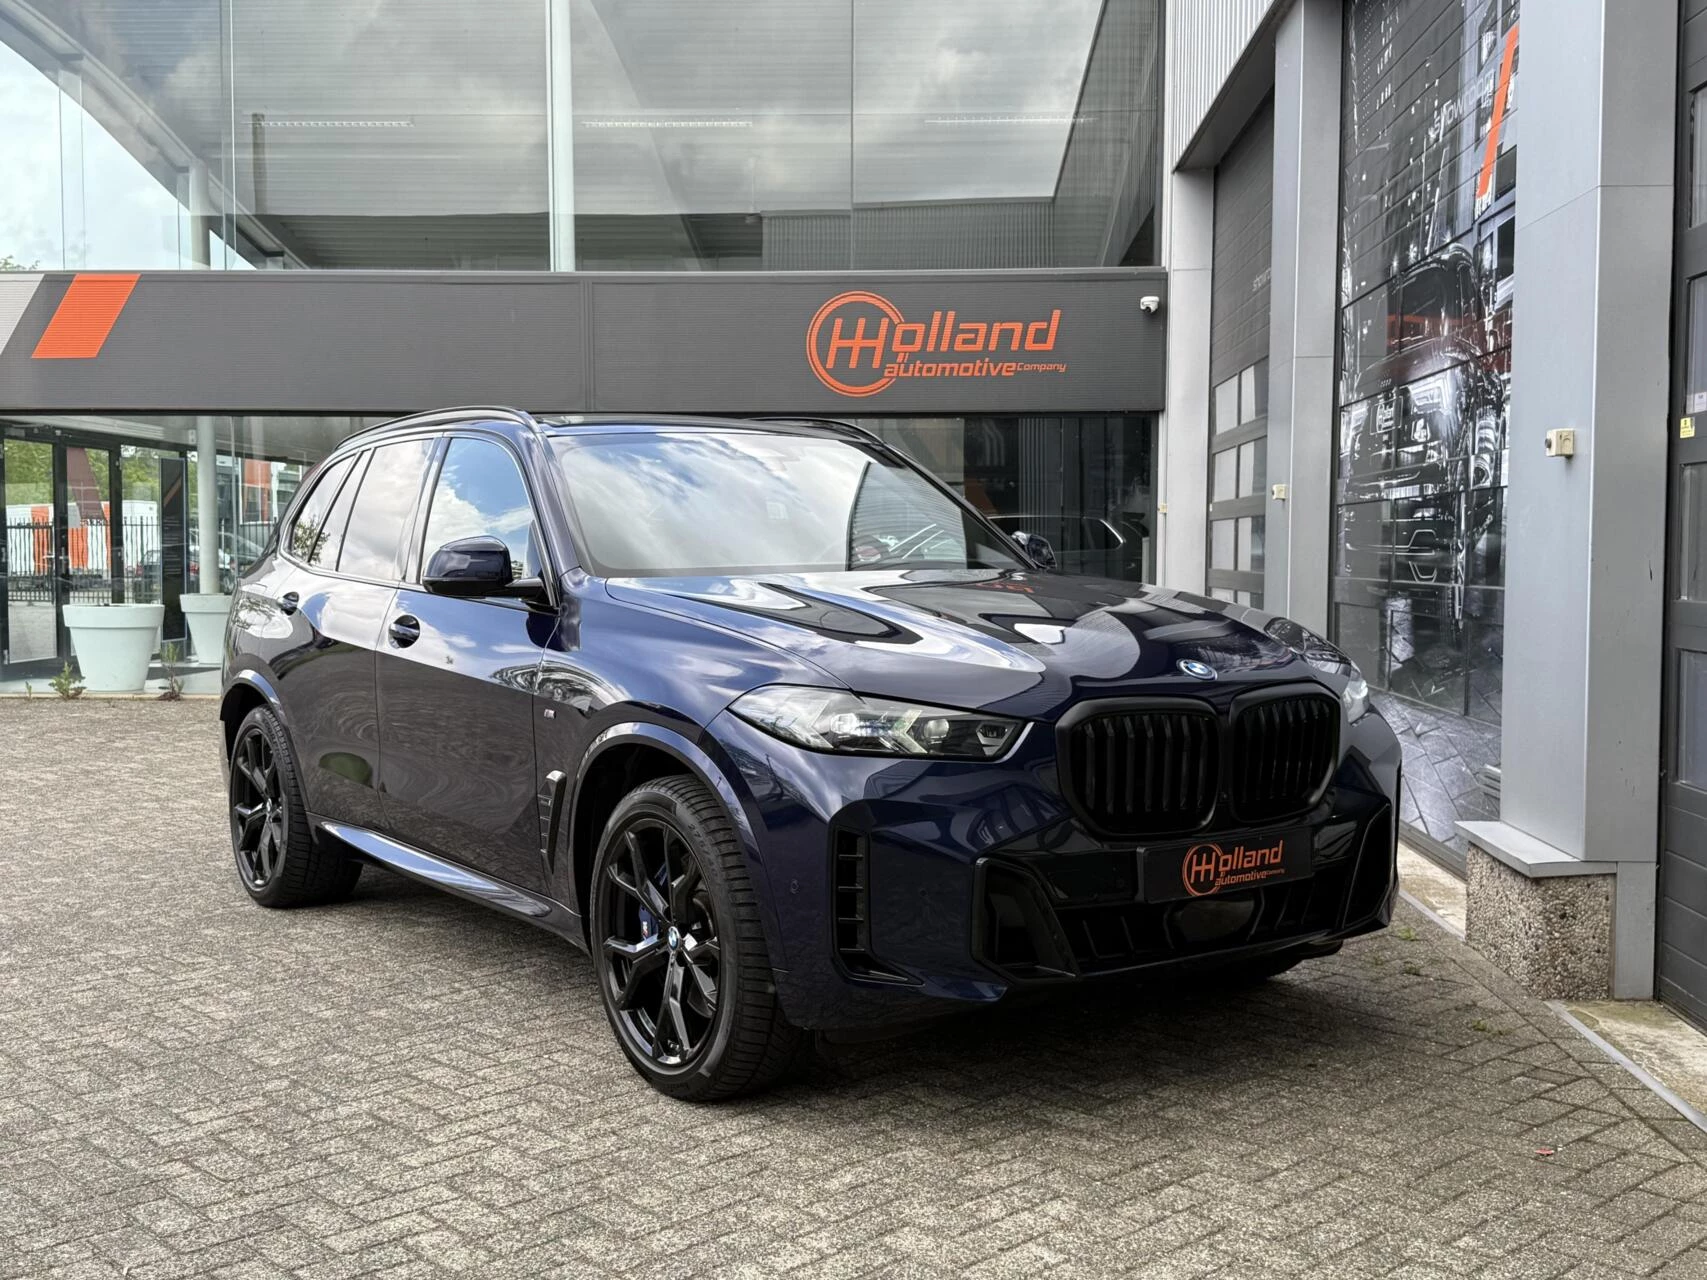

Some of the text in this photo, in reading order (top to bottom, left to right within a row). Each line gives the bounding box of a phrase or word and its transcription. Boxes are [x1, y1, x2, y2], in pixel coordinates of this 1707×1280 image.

[825, 309, 1062, 369] Holland
[883, 357, 1067, 377] automotive Company
[1190, 840, 1284, 883] Holland
[1214, 869, 1267, 886] automotive
